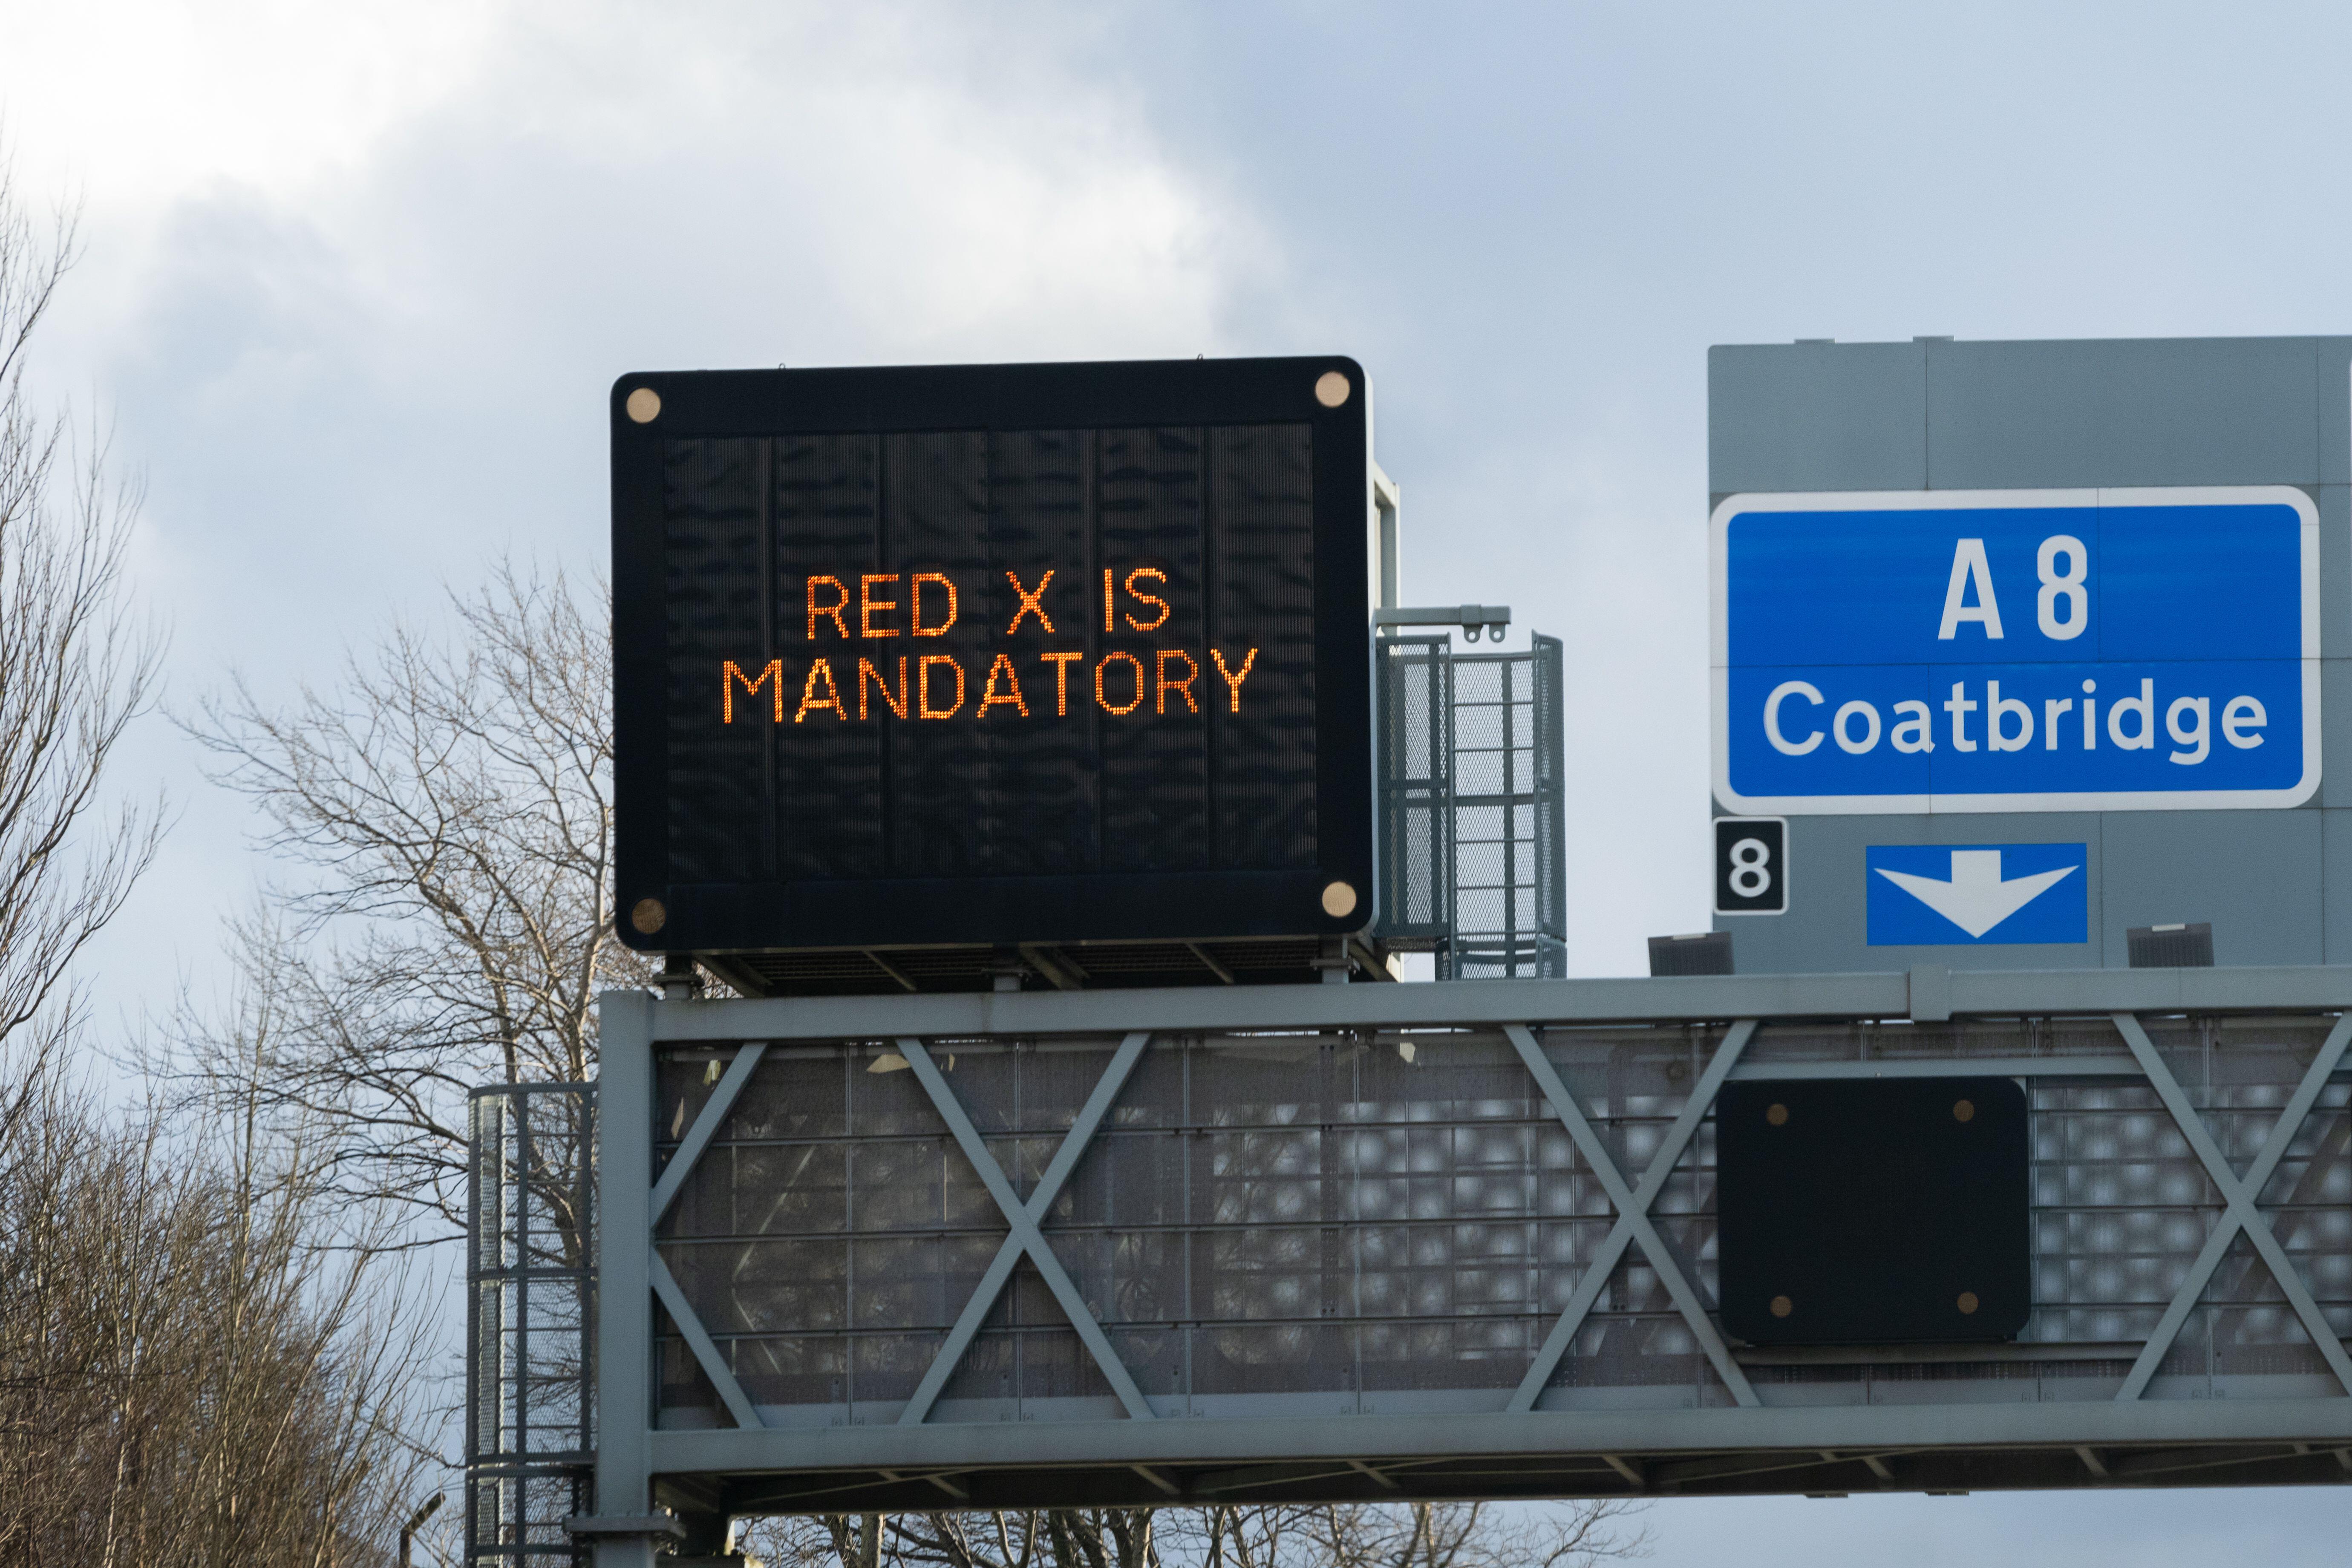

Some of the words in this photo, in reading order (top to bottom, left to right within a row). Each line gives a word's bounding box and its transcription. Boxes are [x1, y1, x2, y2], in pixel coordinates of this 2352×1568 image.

[807, 572, 958, 641] RED
[1005, 569, 1056, 635] X
[1104, 567, 1170, 633] IS
[723, 647, 1259, 724] MANDATORY
[1764, 677, 2268, 766] Coatbridge
[1728, 838, 1771, 897] 8
